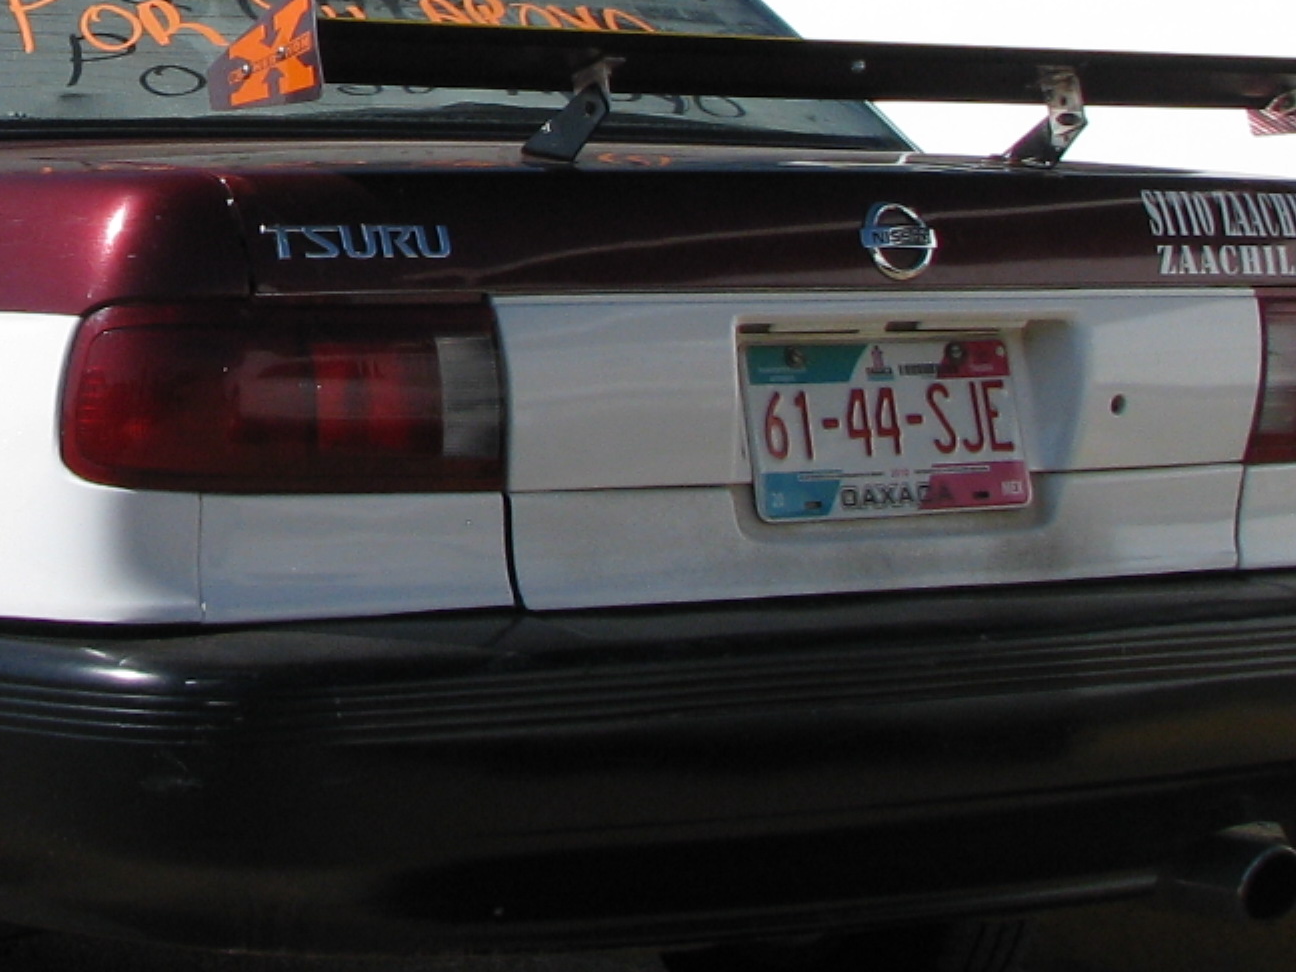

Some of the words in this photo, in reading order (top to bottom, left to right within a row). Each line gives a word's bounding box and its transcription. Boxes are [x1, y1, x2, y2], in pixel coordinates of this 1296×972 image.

[1141, 189, 1215, 237] SITIO
[259, 224, 451, 260] TSURU
[764, 379, 1016, 461] 61-44-SJE
[841, 482, 954, 510] OAXACA
